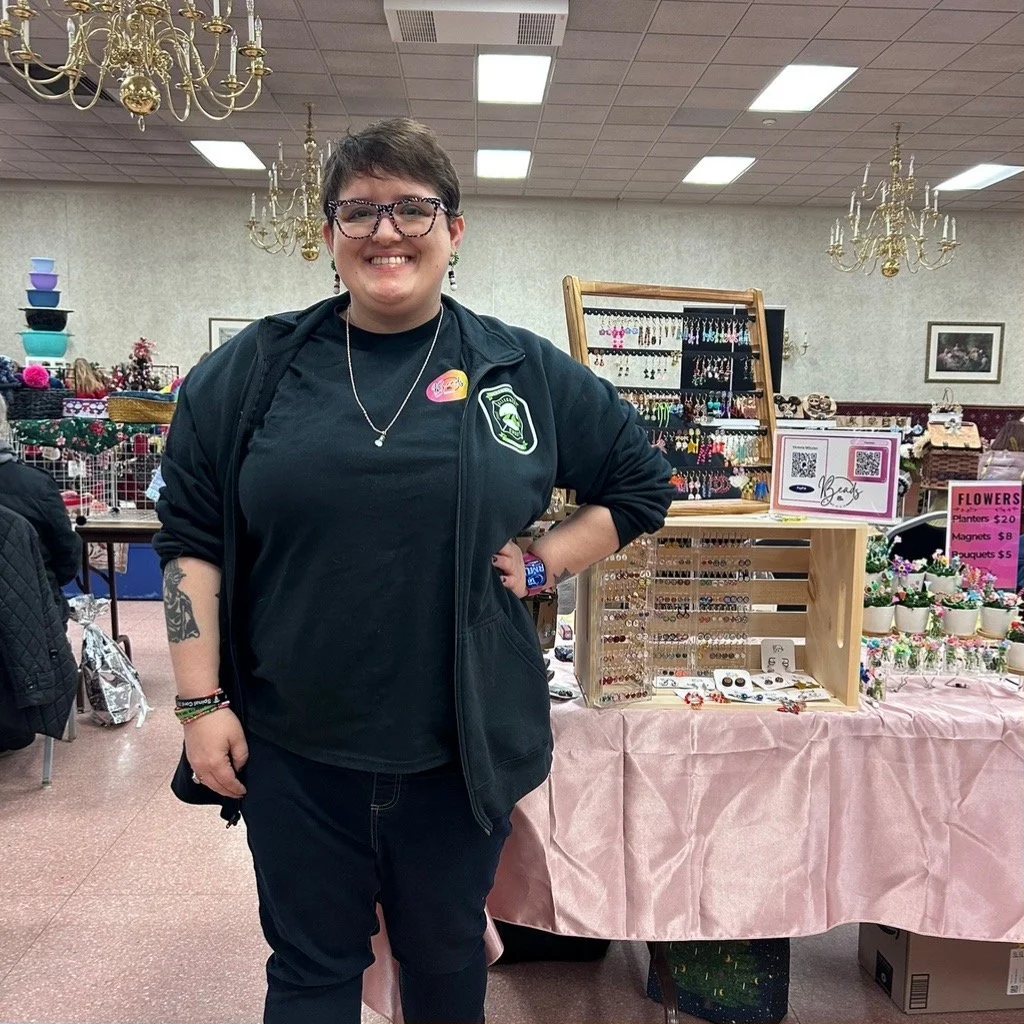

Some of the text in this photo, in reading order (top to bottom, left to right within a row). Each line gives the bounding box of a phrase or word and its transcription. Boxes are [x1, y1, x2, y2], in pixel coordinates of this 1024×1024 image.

[958, 492, 1020, 506] FLOWERS
[952, 514, 1016, 524] Planters $20
[952, 531, 1012, 542] Magnets $8
[951, 550, 1012, 560] Bouquets $5
